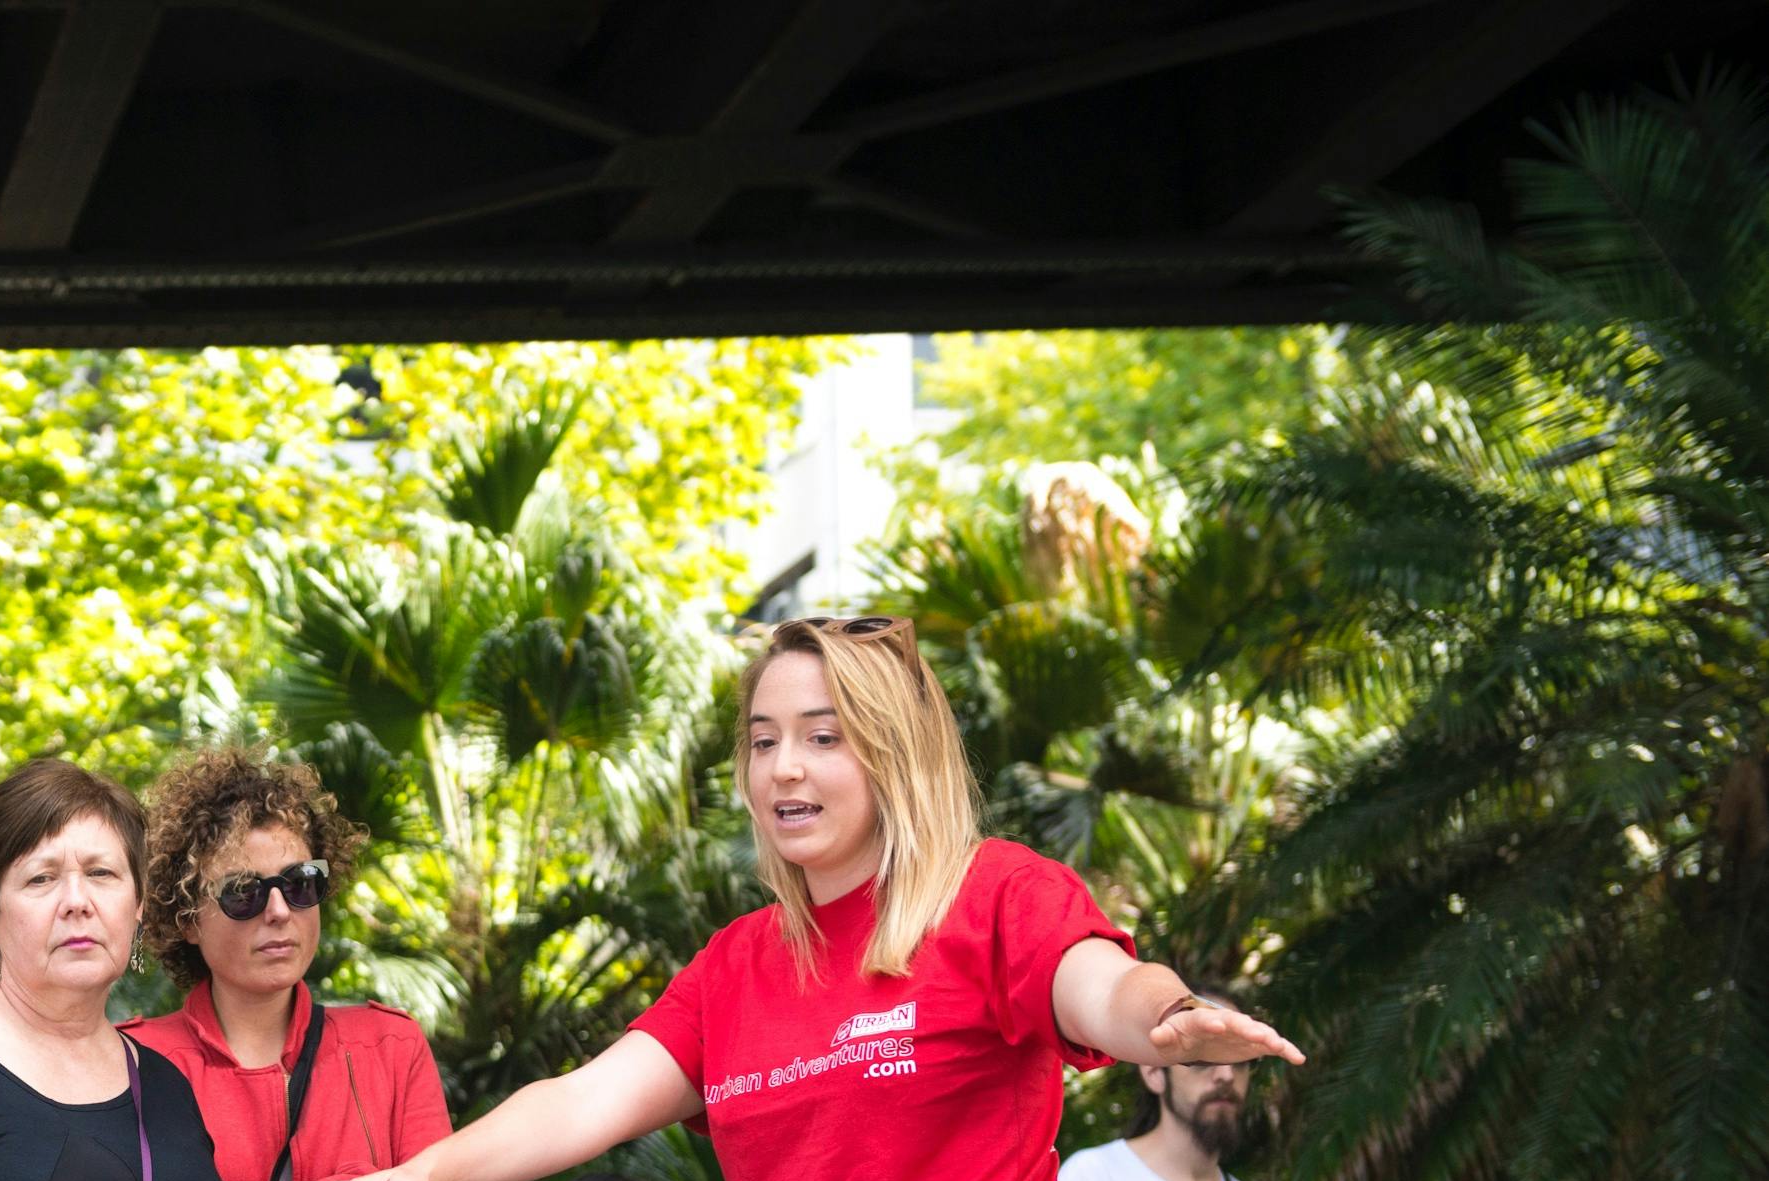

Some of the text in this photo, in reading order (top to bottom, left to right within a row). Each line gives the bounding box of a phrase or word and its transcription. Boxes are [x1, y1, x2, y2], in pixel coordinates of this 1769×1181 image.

[704, 1036, 916, 1104] urban adventures
[862, 1059, 917, 1079] .com
